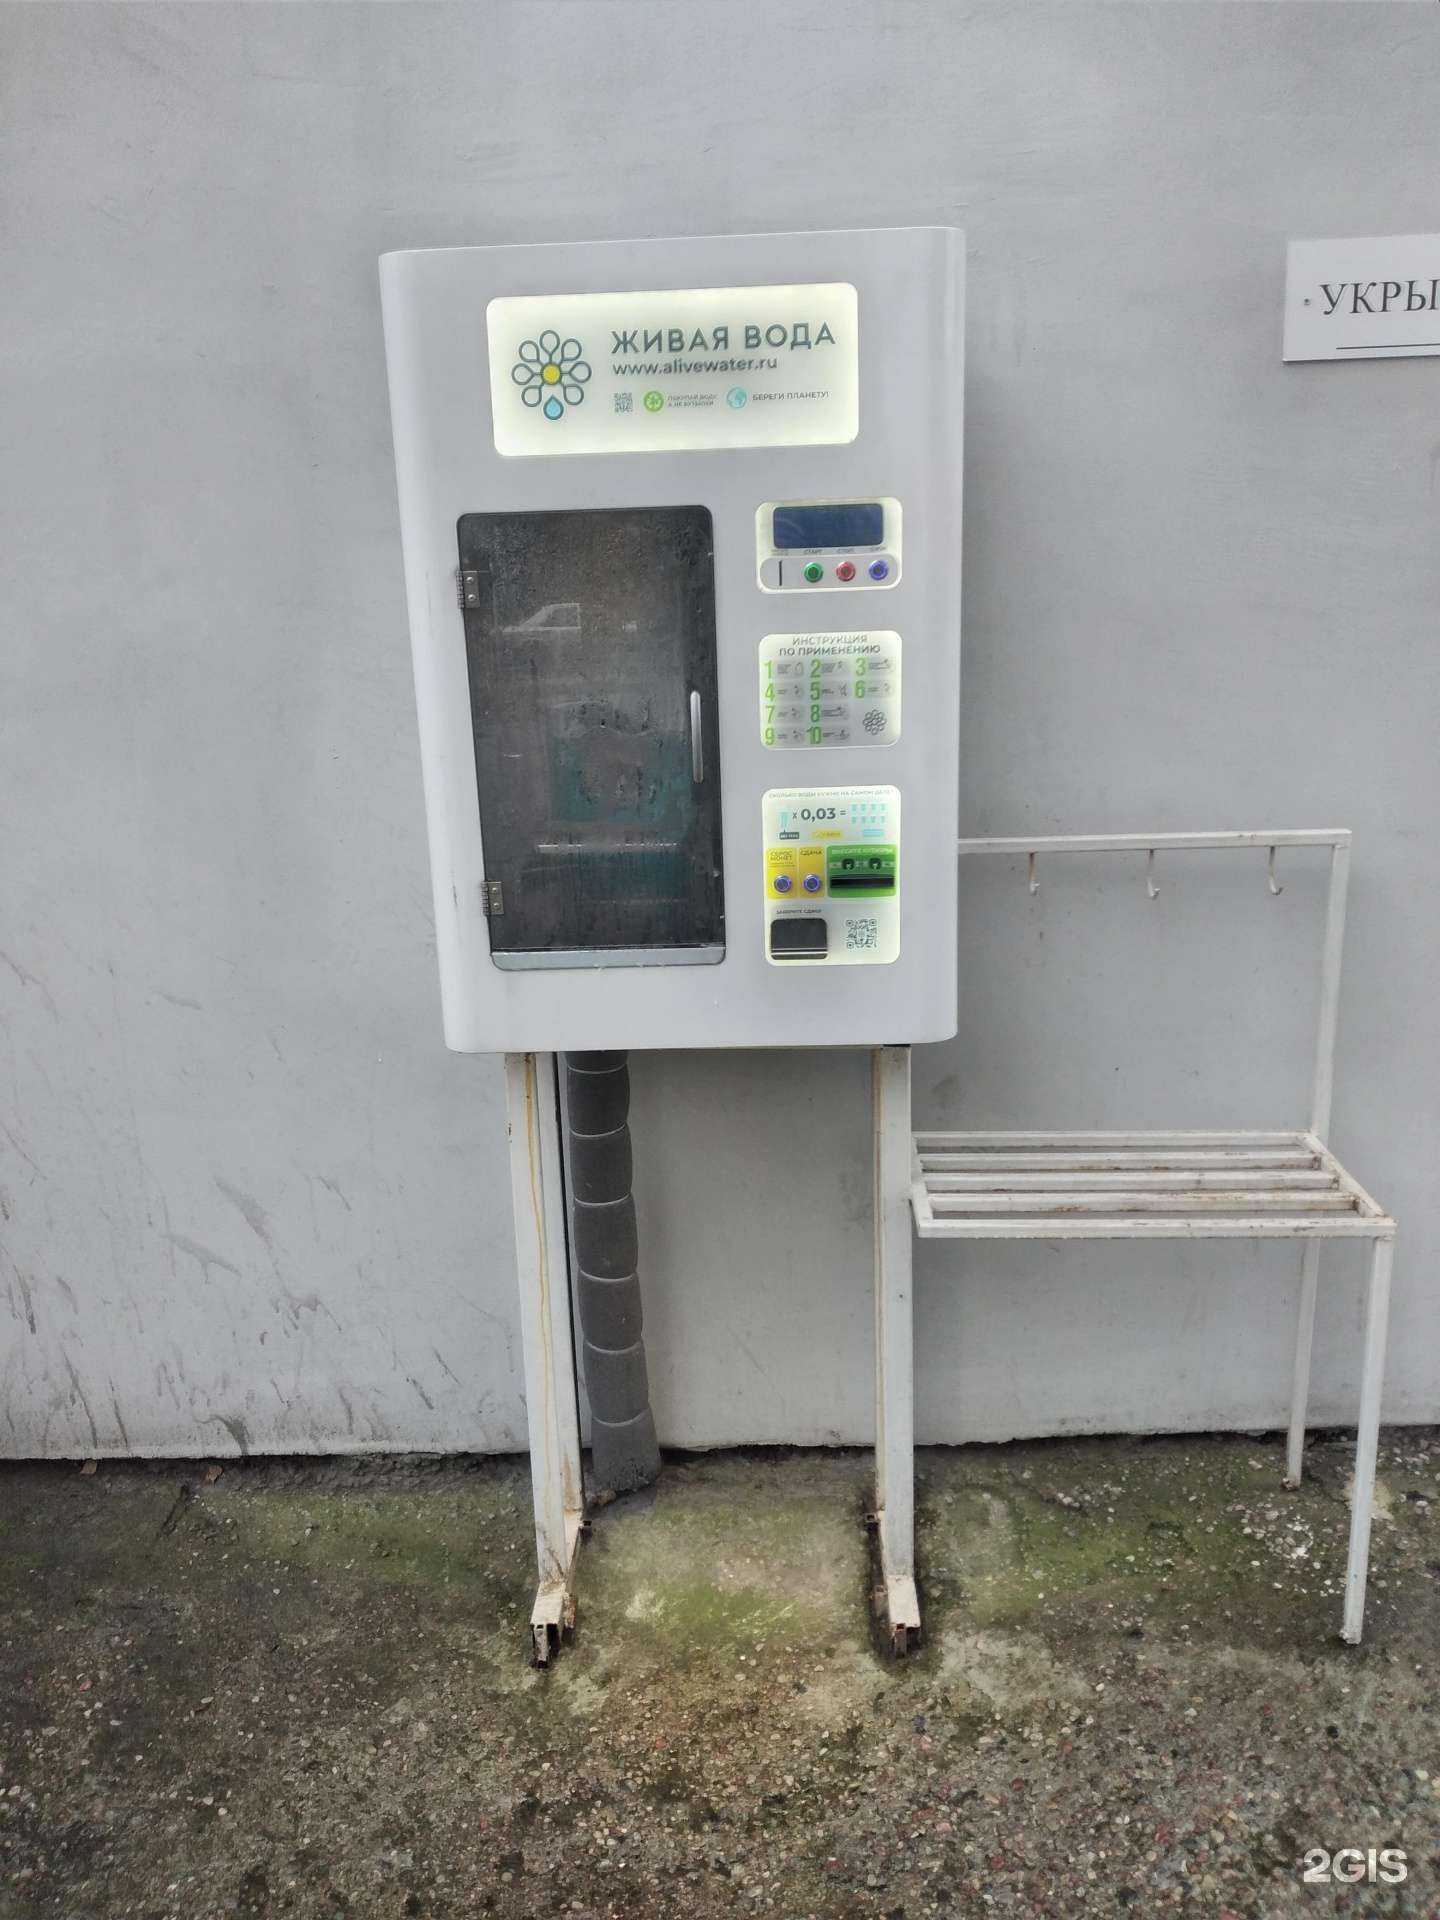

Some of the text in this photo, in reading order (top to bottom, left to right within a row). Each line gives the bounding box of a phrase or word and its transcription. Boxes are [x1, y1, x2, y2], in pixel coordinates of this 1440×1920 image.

[611, 322, 836, 354] ЖИВАЯ ВОДА
[612, 357, 778, 376] www.alivewater.ru
[752, 390, 829, 401] БЕРЕГИ ПЛАНЕТУ!
[792, 635, 868, 646] ИНСТРУКЦИЯ
[779, 645, 881, 656] ПО ПРИМЕНЕНИЮ
[764, 660, 773, 679] 1
[810, 658, 821, 678] 2
[855, 657, 866, 676] 3
[764, 683, 775, 701] 4
[810, 681, 820, 701] 5
[855, 680, 865, 699] 6
[765, 705, 775, 723] 7
[810, 704, 820, 722] 8
[765, 727, 774, 745] 9
[806, 726, 821, 744] 10
[800, 807, 836, 823] 0,03
